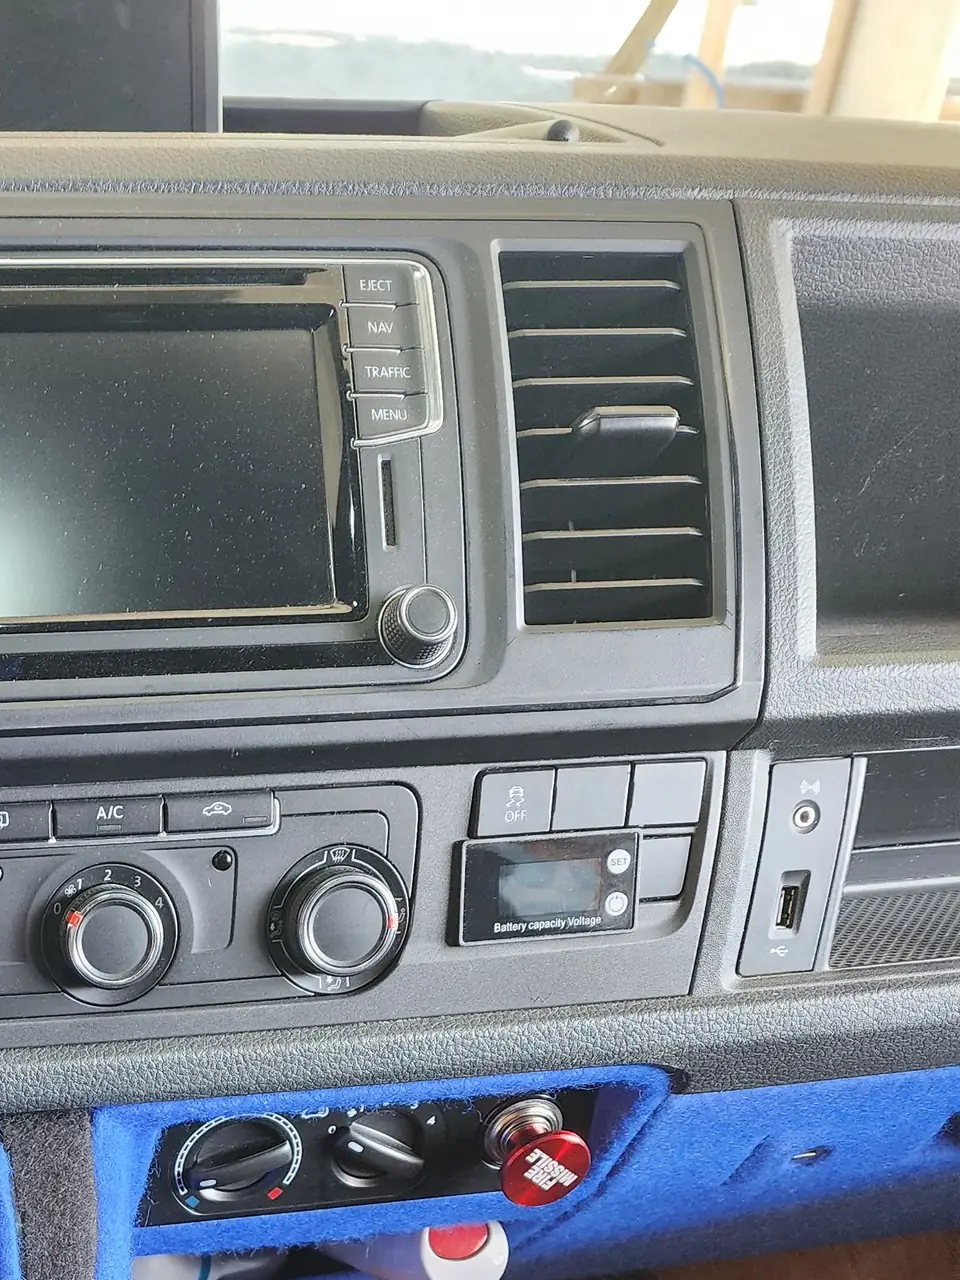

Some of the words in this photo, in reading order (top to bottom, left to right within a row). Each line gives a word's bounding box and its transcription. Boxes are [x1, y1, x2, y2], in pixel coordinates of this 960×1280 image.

[359, 279, 392, 291] EJECT
[368, 321, 394, 333] NAV
[364, 365, 411, 378] TRAFFIC
[371, 408, 408, 421] MENU
[96, 804, 124, 820] A/C
[504, 809, 528, 823] OFF
[609, 855, 629, 867] SET
[76, 877, 84, 891] 1
[103, 869, 113, 881] 2
[134, 875, 142, 888] 3
[154, 896, 165, 909] 4
[493, 921, 528, 934] Battery
[528, 917, 567, 931] capacity
[567, 915, 602, 927] Voltage
[425, 1115, 437, 1126] 4
[525, 1148, 579, 1187] MISSILE
[523, 1165, 558, 1191] FIRE
